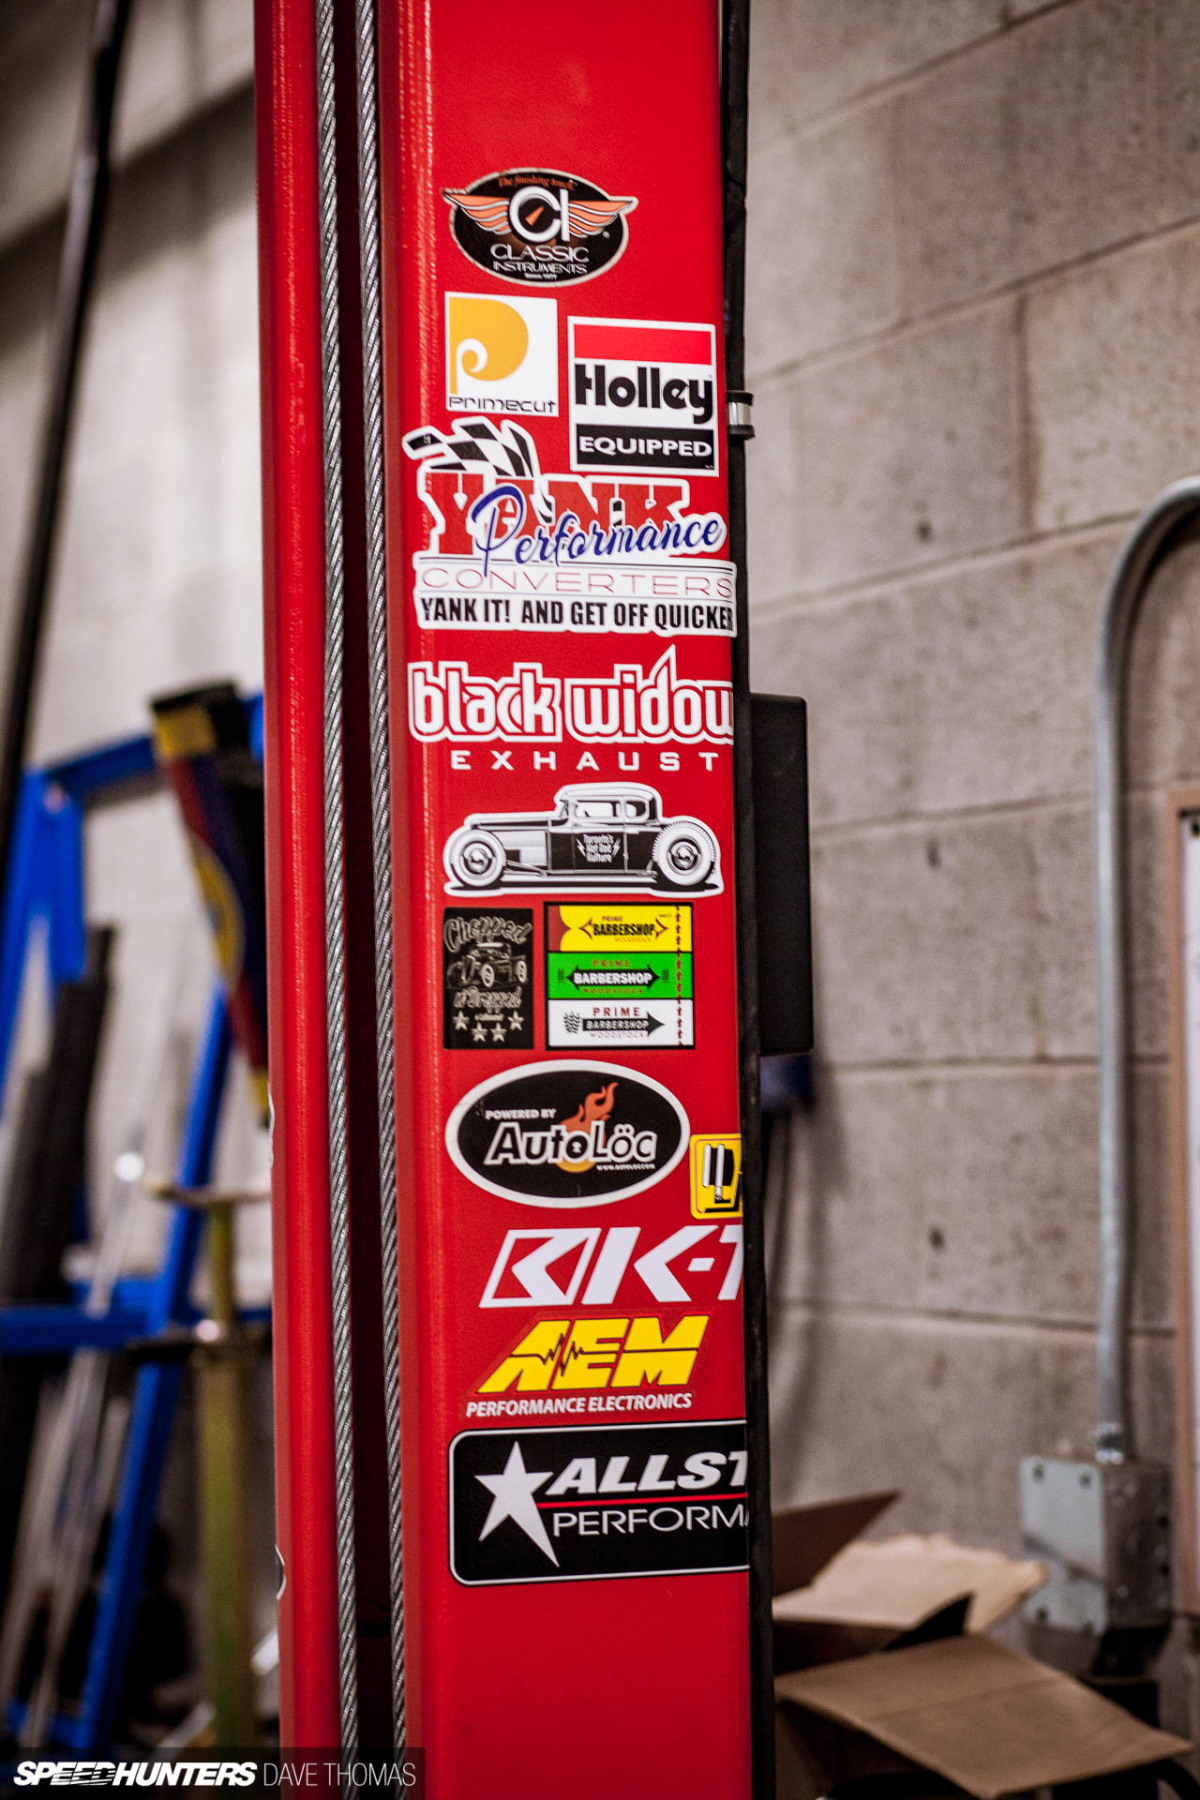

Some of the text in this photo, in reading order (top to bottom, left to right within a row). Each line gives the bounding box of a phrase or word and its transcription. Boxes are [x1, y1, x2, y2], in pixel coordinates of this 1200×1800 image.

[490, 243, 590, 263] CLASSIC
[492, 260, 588, 274] INSTRUMENTS
[574, 362, 713, 425] Holley
[578, 435, 713, 458] EQUIPPED
[470, 483, 722, 578] Performance
[421, 567, 735, 598] CONVERTERS
[420, 597, 734, 631] YANK IT! AND GET OFF QUICKER
[408, 661, 562, 742] black
[450, 750, 719, 771] EXHAUST
[593, 923, 655, 936] BARBERSHOP
[592, 959, 630, 967] PRIME
[573, 971, 653, 984] BARBERSHOP
[592, 1006, 641, 1017] PRIME
[586, 1020, 649, 1030] BARBERSHOP
[485, 1108, 557, 1120] POWERED BY
[476, 1314, 711, 1394] AEM
[466, 1392, 693, 1418] PERFORMANCE ELECTRONICS
[553, 1503, 749, 1537] PERFORM
